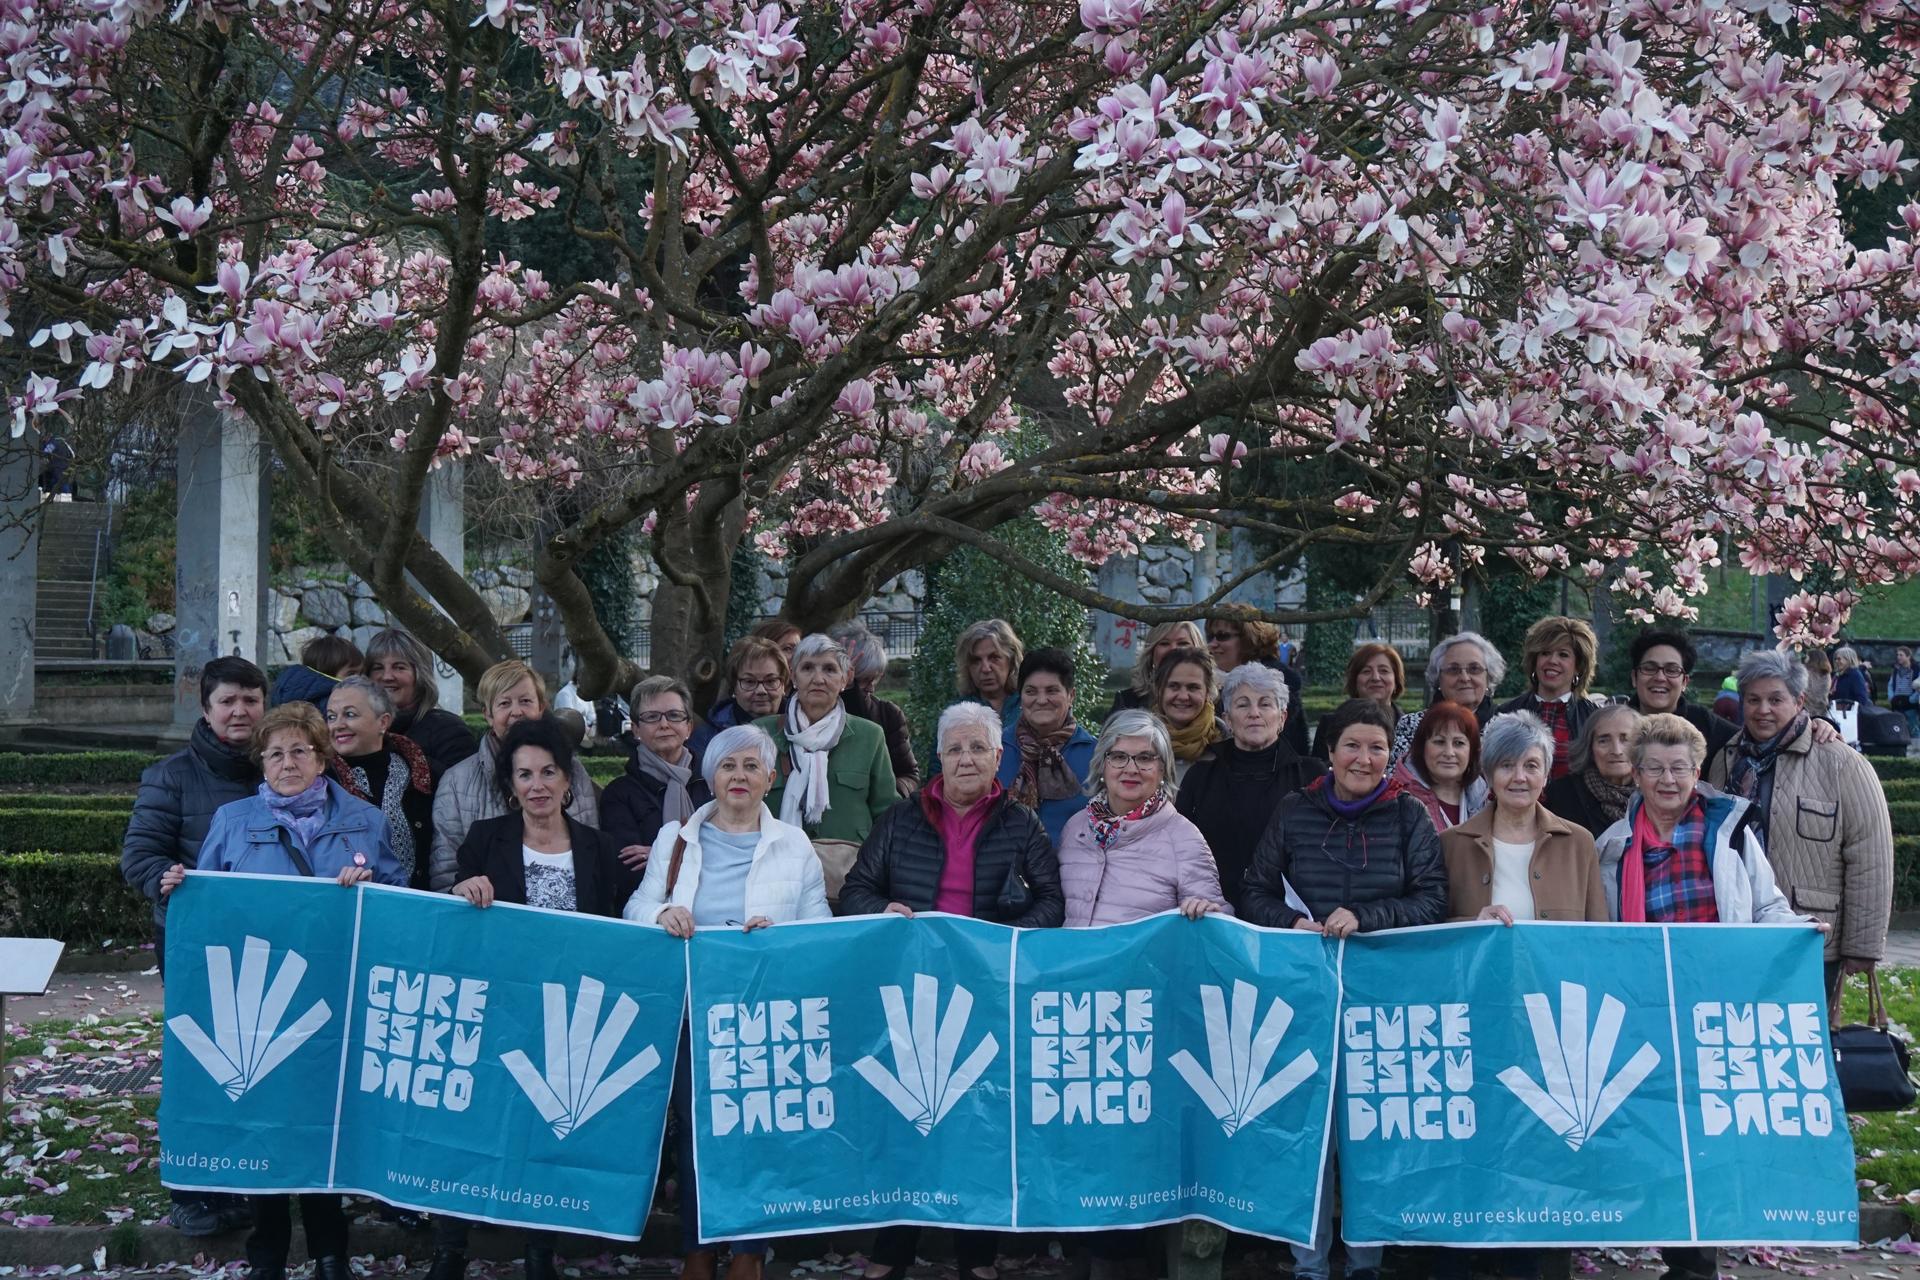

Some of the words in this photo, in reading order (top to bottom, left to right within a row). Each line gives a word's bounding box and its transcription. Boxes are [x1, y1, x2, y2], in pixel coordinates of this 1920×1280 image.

[367, 964, 489, 1023] GURE
[1031, 989, 1153, 1035] GURE
[364, 1006, 482, 1066] ESKU
[707, 997, 830, 1047] GURE
[1343, 1003, 1471, 1050] GURE
[1692, 1001, 1823, 1047] GURE
[708, 1041, 832, 1090] ESKU
[1031, 1034, 1153, 1079] ESKU
[1345, 1049, 1474, 1094] ESKU
[1696, 1046, 1828, 1090] ESKU
[359, 1049, 475, 1113] DAGO
[1031, 1080, 1152, 1125] DAGO
[710, 1086, 835, 1136] DAGO
[1347, 1095, 1476, 1141] DAGO
[1700, 1092, 1833, 1137] DAGO
[160, 1149, 270, 1172] skudago.eus
[387, 1168, 590, 1212] www.gureeskudago.eus
[763, 1187, 959, 1216] www.gureeskudago.eus
[1080, 1182, 1255, 1213] www.gureeskudago.eus
[1401, 1207, 1623, 1227] www.gureeskudago.eus
[1763, 1208, 1859, 1226] www.gure
